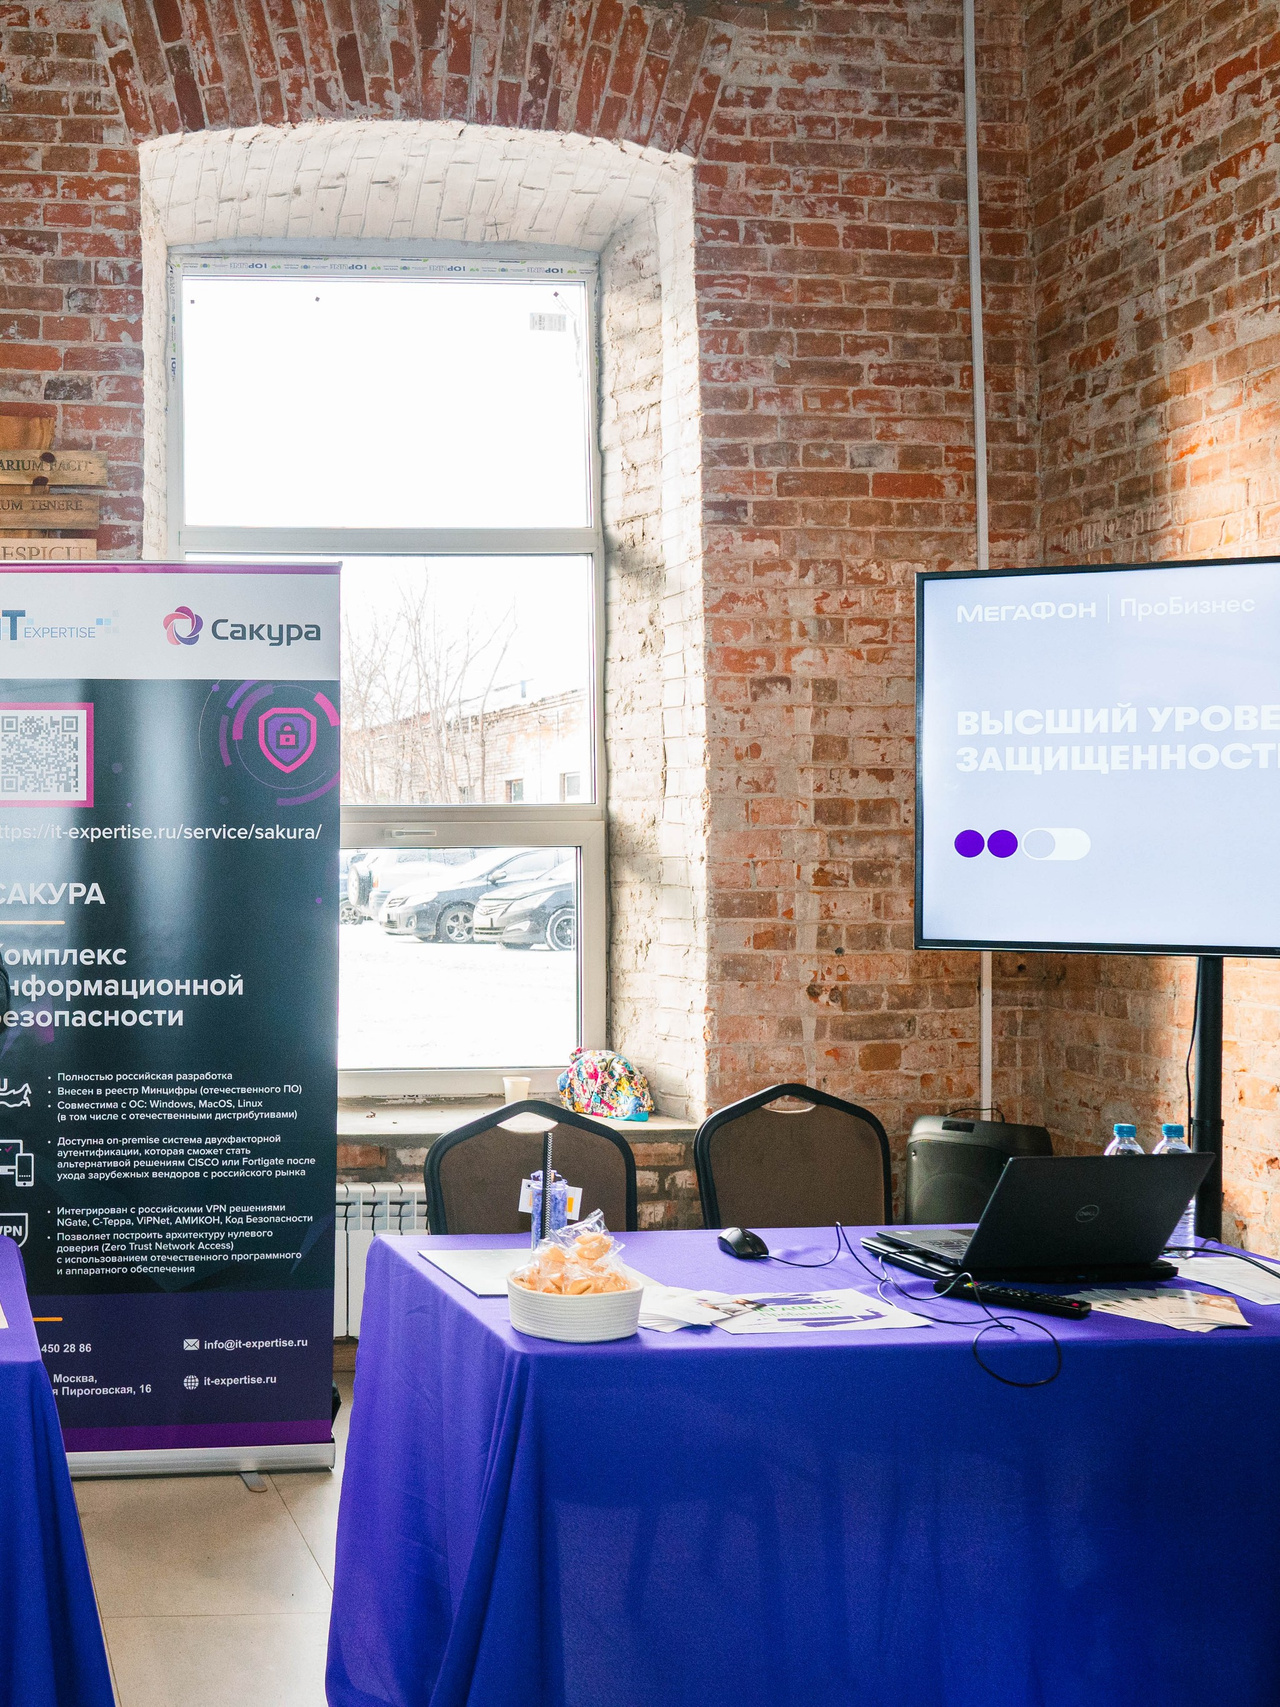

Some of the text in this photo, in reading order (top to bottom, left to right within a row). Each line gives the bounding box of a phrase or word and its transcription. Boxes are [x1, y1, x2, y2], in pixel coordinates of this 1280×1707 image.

[31, 499, 83, 511] TENERE
[1121, 596, 1256, 621] ПроБизнес
[24, 627, 96, 639] EXPERTISE
[211, 618, 321, 646] Сакура
[957, 703, 1137, 735] ВЫСШИЙ
[955, 743, 1280, 775] ЗАЩИЩЕННОСТ
[10, 974, 244, 1002] нформационной
[58, 1072, 232, 1082] Полностью российская разработка
[58, 1087, 93, 1095] Внесен
[105, 1088, 138, 1096] реестр
[142, 1086, 197, 1096] Минцифры
[200, 1086, 281, 1096] (отечественного
[284, 1085, 302, 1094] ПО)
[57, 1101, 118, 1109] Совместима
[129, 1100, 147, 1108] ОС:
[150, 1100, 196, 1109] Windows,
[199, 1100, 235, 1109] MacOS,
[238, 1099, 263, 1108] Linux
[57, 1113, 66, 1122] (в
[90, 1113, 118, 1121] числе
[130, 1112, 212, 1120] отечественными
[215, 1110, 298, 1120] дистрибутивами)
[57, 1135, 281, 1147] Доступна on-premise система двухфакторной
[57, 1148, 142, 1158] аутентификации,
[144, 1148, 184, 1157] которая
[57, 1159, 130, 1169] альтернативой
[134, 1160, 185, 1168] решениям
[188, 1158, 219, 1166] CISCO
[242, 1158, 284, 1167] Fortigate
[57, 1172, 85, 1181] ухода
[88, 1171, 149, 1180] зарубежных
[152, 1171, 200, 1179] вендоров
[211, 1170, 272, 1179] российского
[275, 1169, 306, 1178] рынка
[57, 1207, 128, 1216] Интегрирован
[138, 1205, 202, 1215] российскими
[206, 1204, 226, 1213] VPN
[230, 1204, 285, 1214] решениями
[57, 1218, 90, 1227] NGate,
[137, 1217, 172, 1226] ViPNet,
[175, 1216, 222, 1225] АМИКОН,
[226, 1216, 243, 1224] Код
[246, 1215, 313, 1224] Безопасности
[57, 1230, 273, 1241] Позволяет построить архитектуру нулевого
[56, 1242, 234, 1254] доверия (Zero Trust Network Access)
[41, 1343, 92, 1353] 450 28 86
[204, 1338, 308, 1351] info@it-expertise.ru
[53, 1374, 98, 1384] Москва,
[204, 1375, 277, 1387] it-expertise.ru
[62, 1386, 136, 1397] Пироговская,
[139, 1384, 152, 1393] 16
